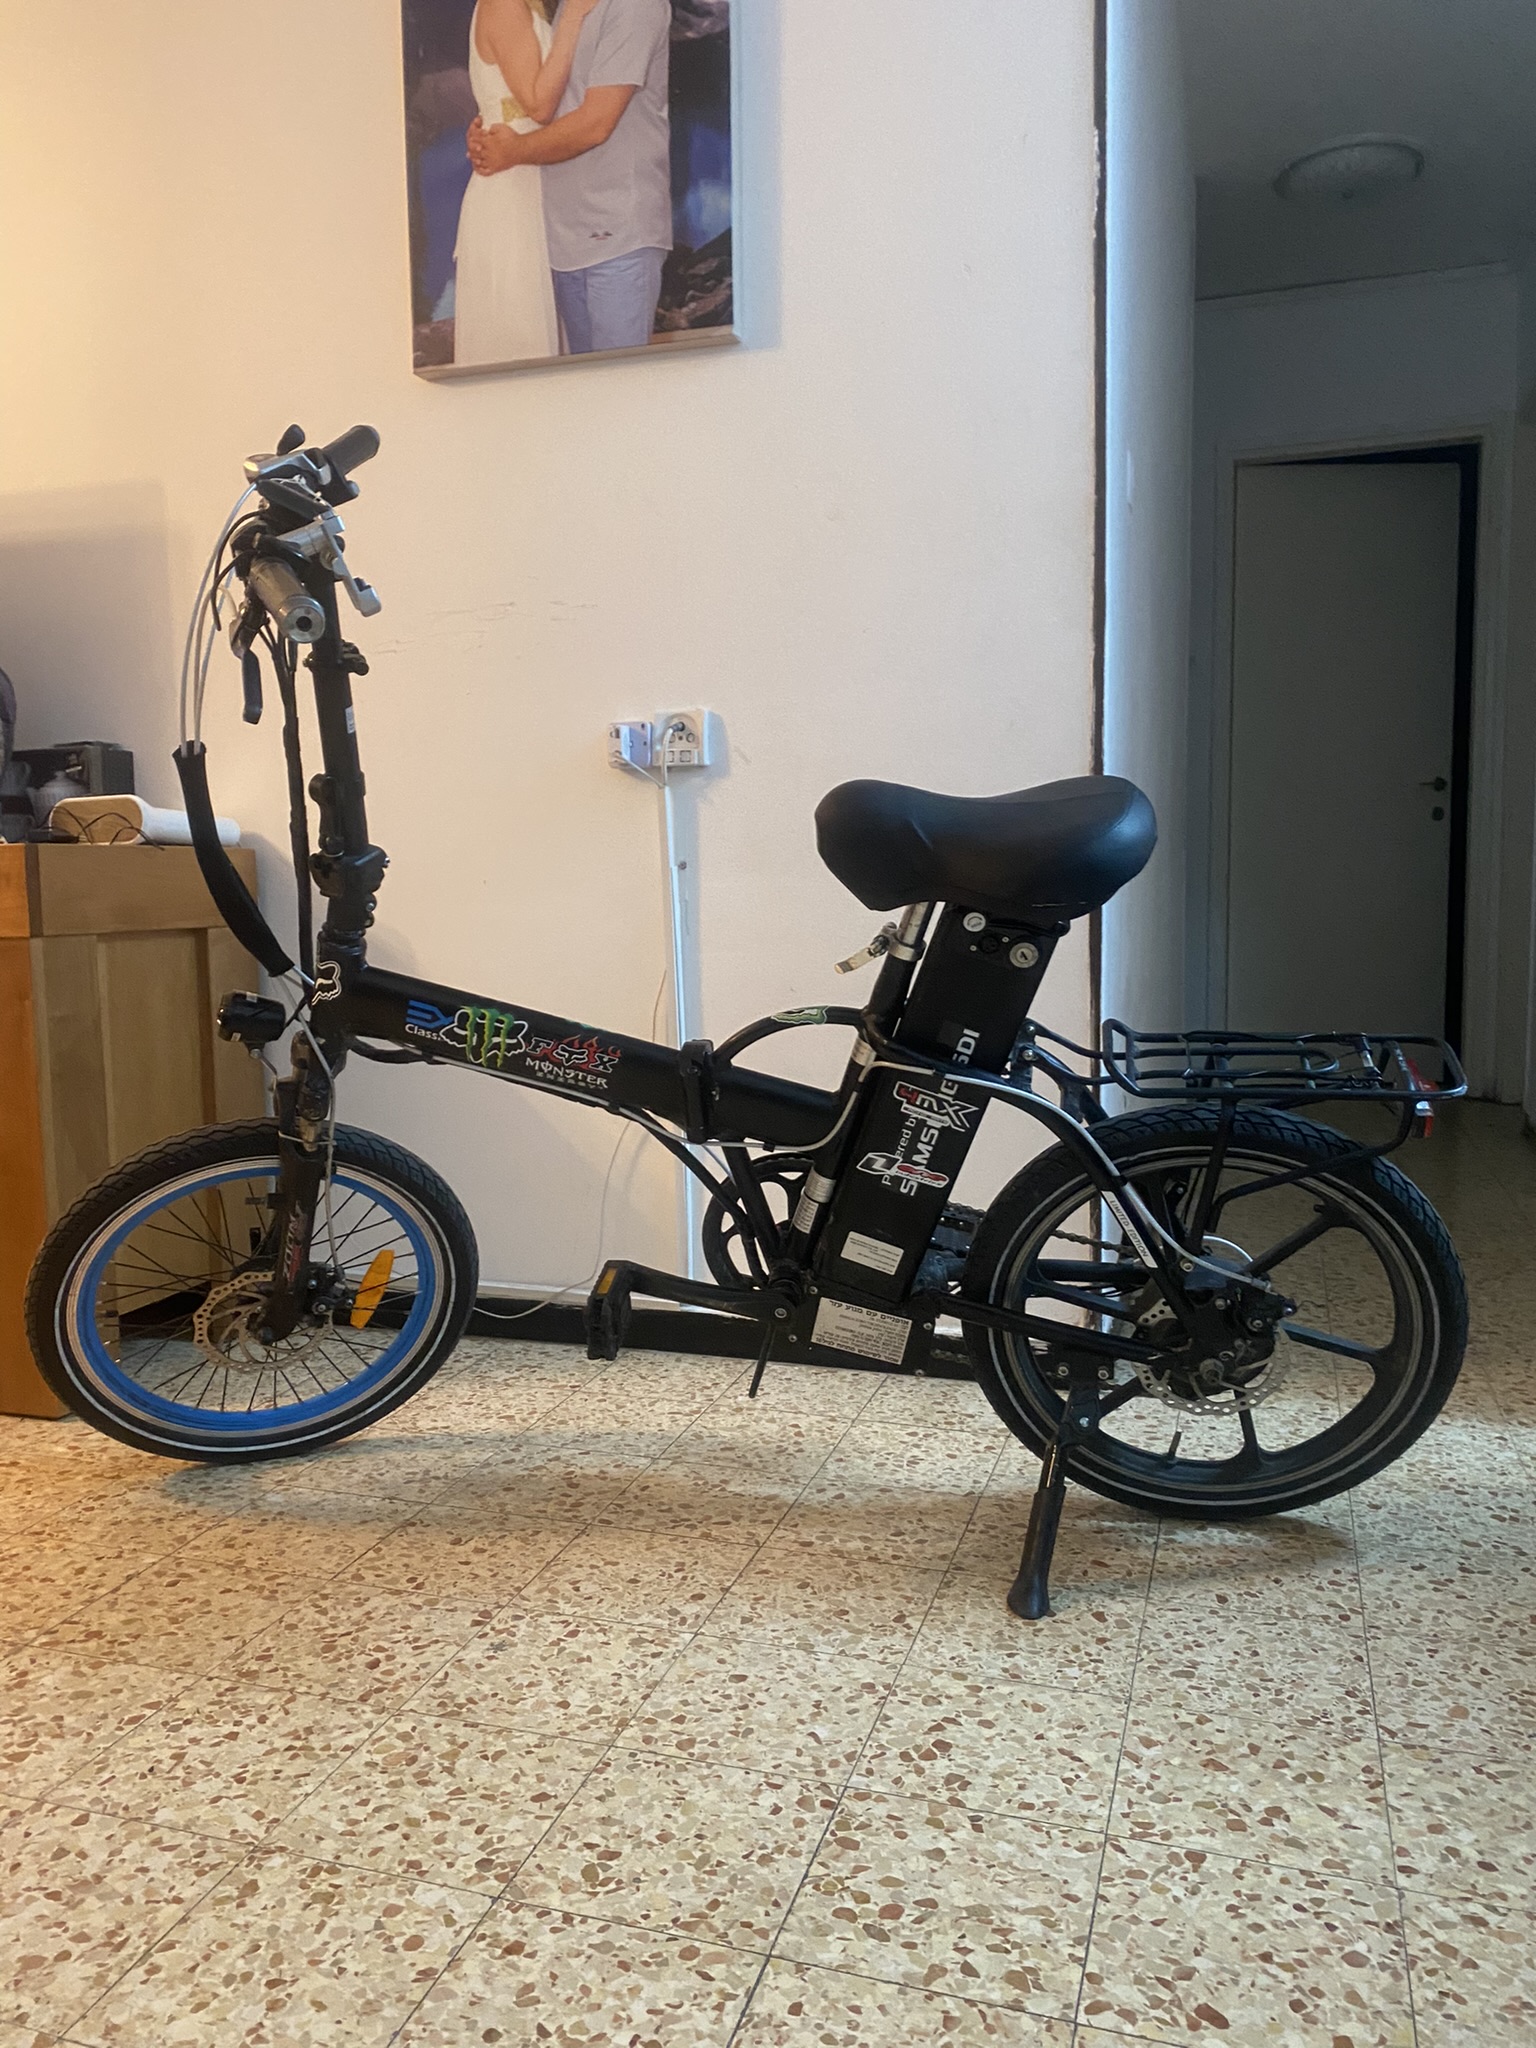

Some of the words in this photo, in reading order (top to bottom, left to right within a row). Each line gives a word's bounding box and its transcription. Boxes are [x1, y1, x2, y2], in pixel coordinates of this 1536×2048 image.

[881, 1128, 913, 1186] Pered
[1110, 1200, 1130, 1227] LIMITED
[1128, 1228, 1148, 1257] EDITION
[866, 1310, 878, 1318] עם
[880, 1313, 909, 1325] אופניים
